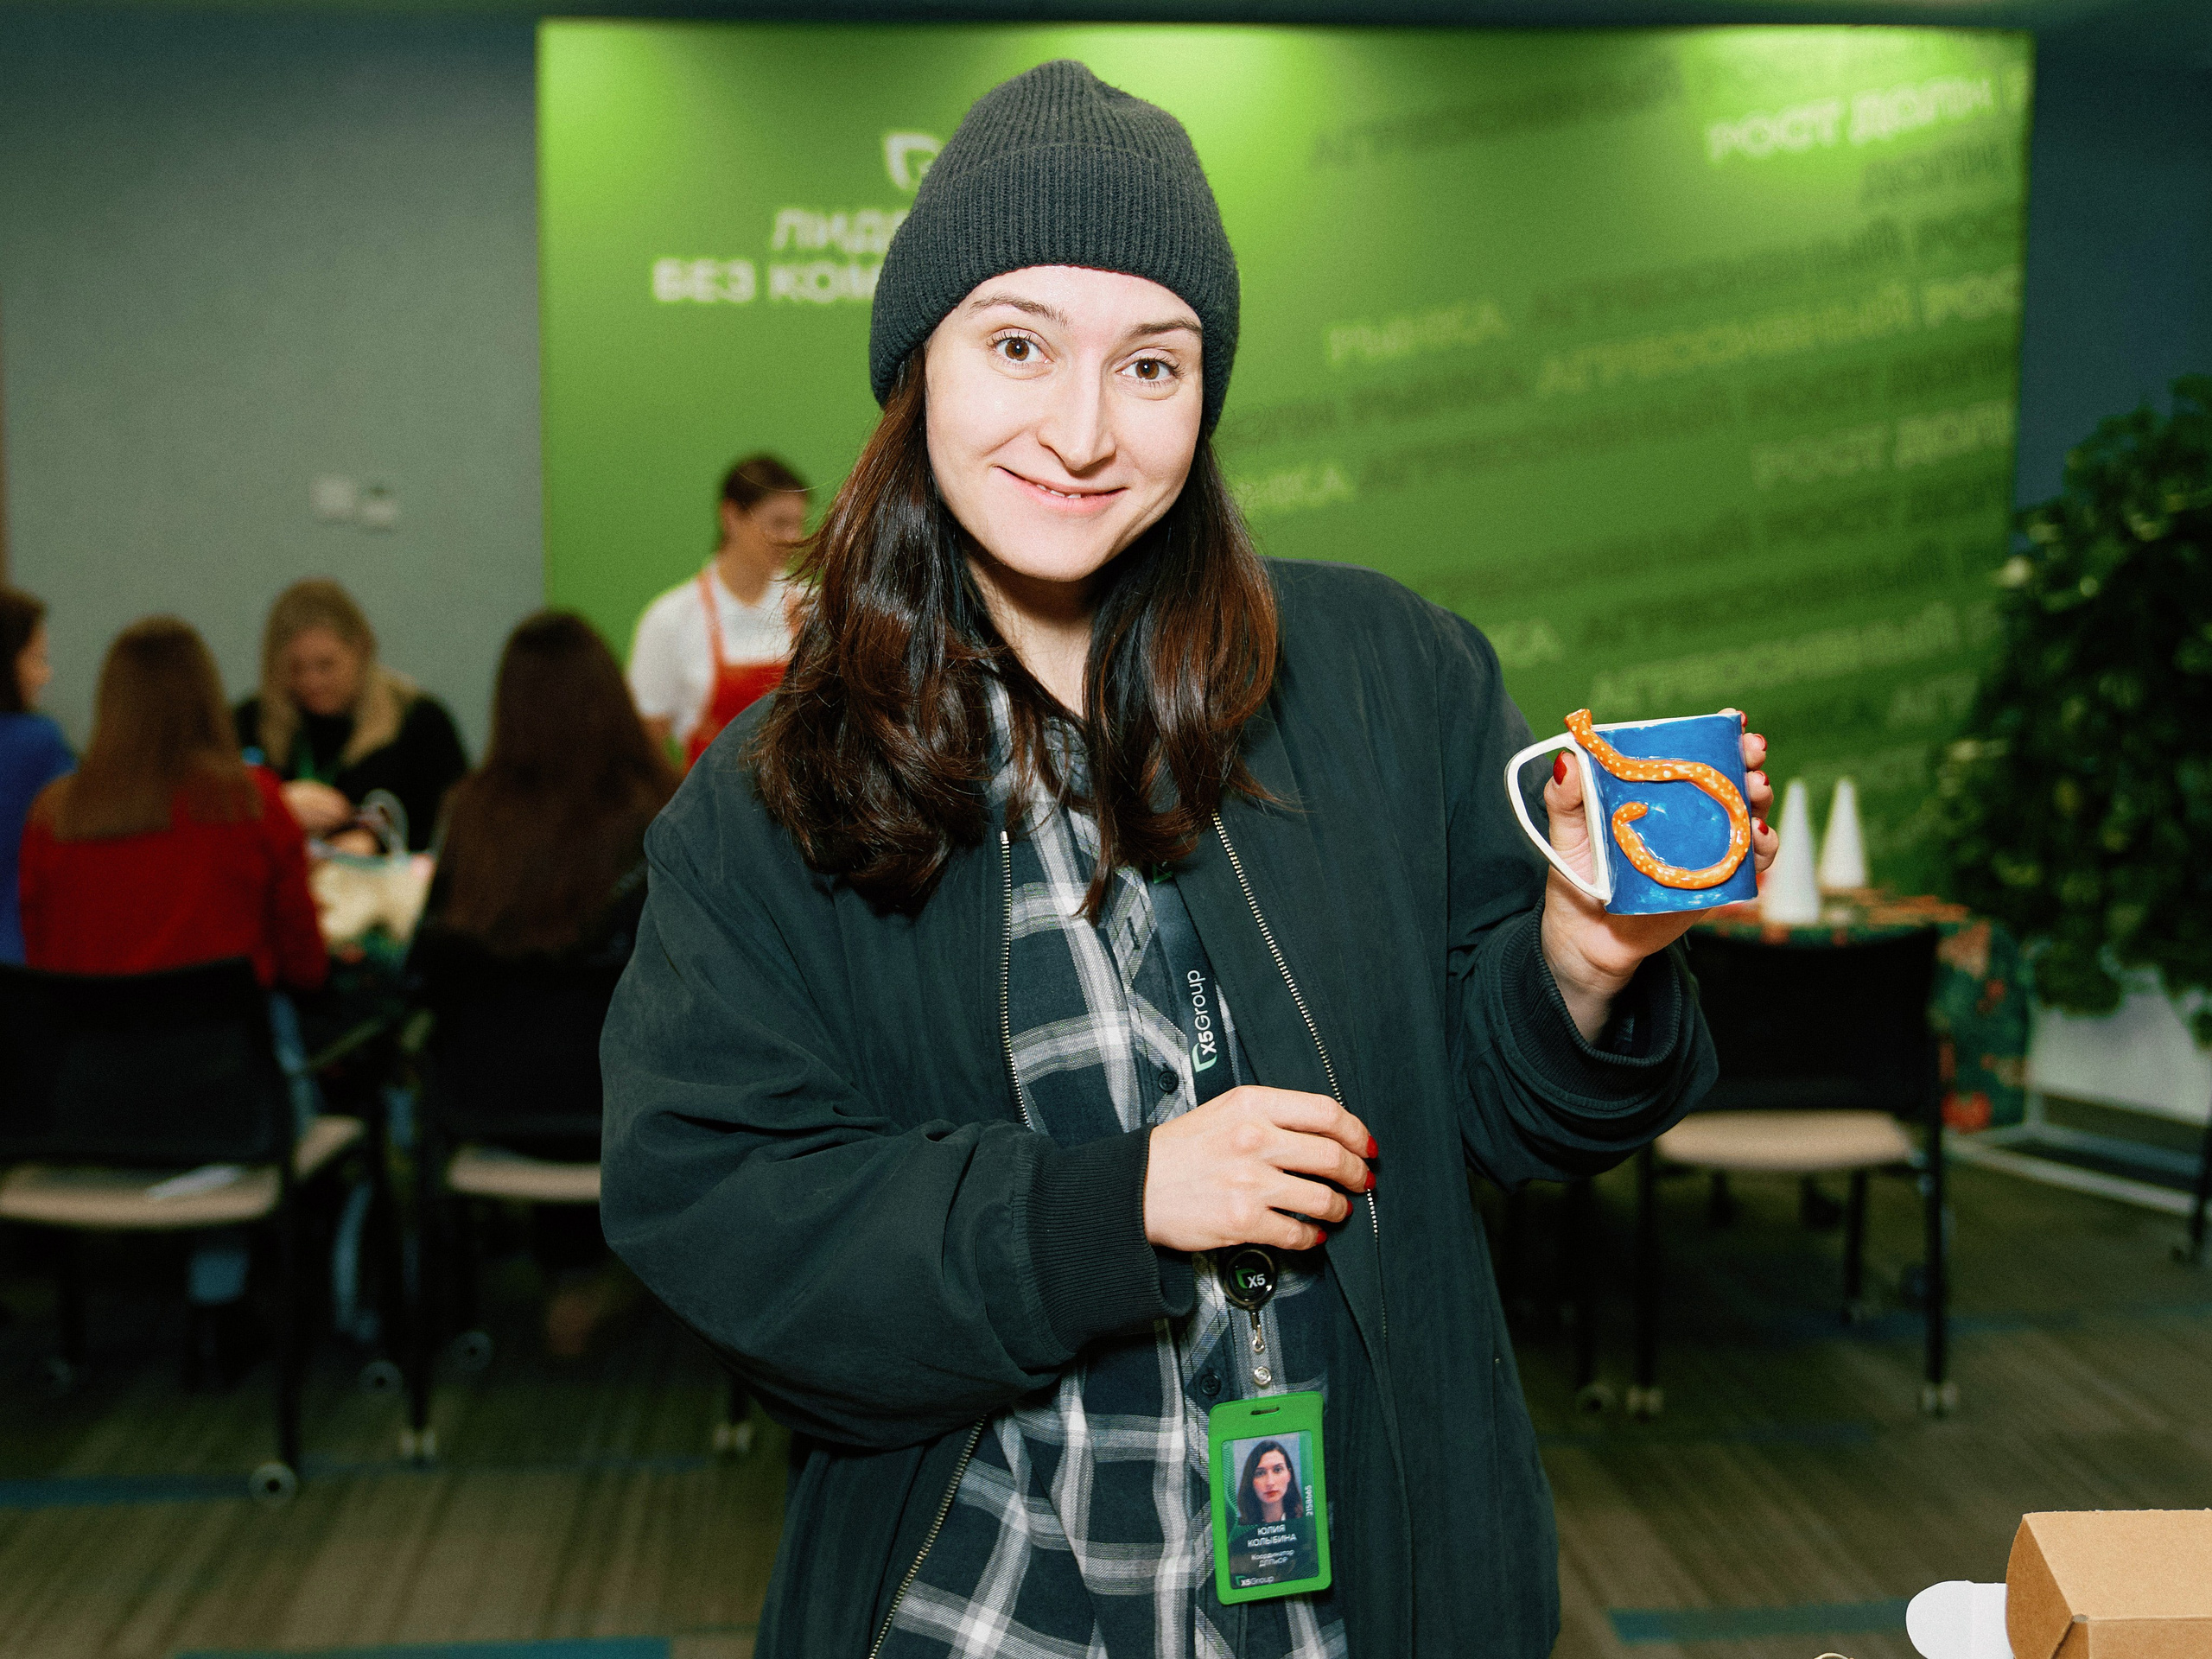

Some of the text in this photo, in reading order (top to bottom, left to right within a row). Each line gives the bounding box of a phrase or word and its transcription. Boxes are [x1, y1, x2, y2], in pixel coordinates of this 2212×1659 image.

[1707, 96, 1842, 164] РОСТ
[1847, 78, 1993, 147] ДОЛИ
[772, 208, 907, 252] ЛИД
[652, 259, 757, 302] БЕЗ
[1247, 1534, 1297, 1548] КОЛЫБИНА
[1257, 1524, 1286, 1535] ЮЛИЯ
